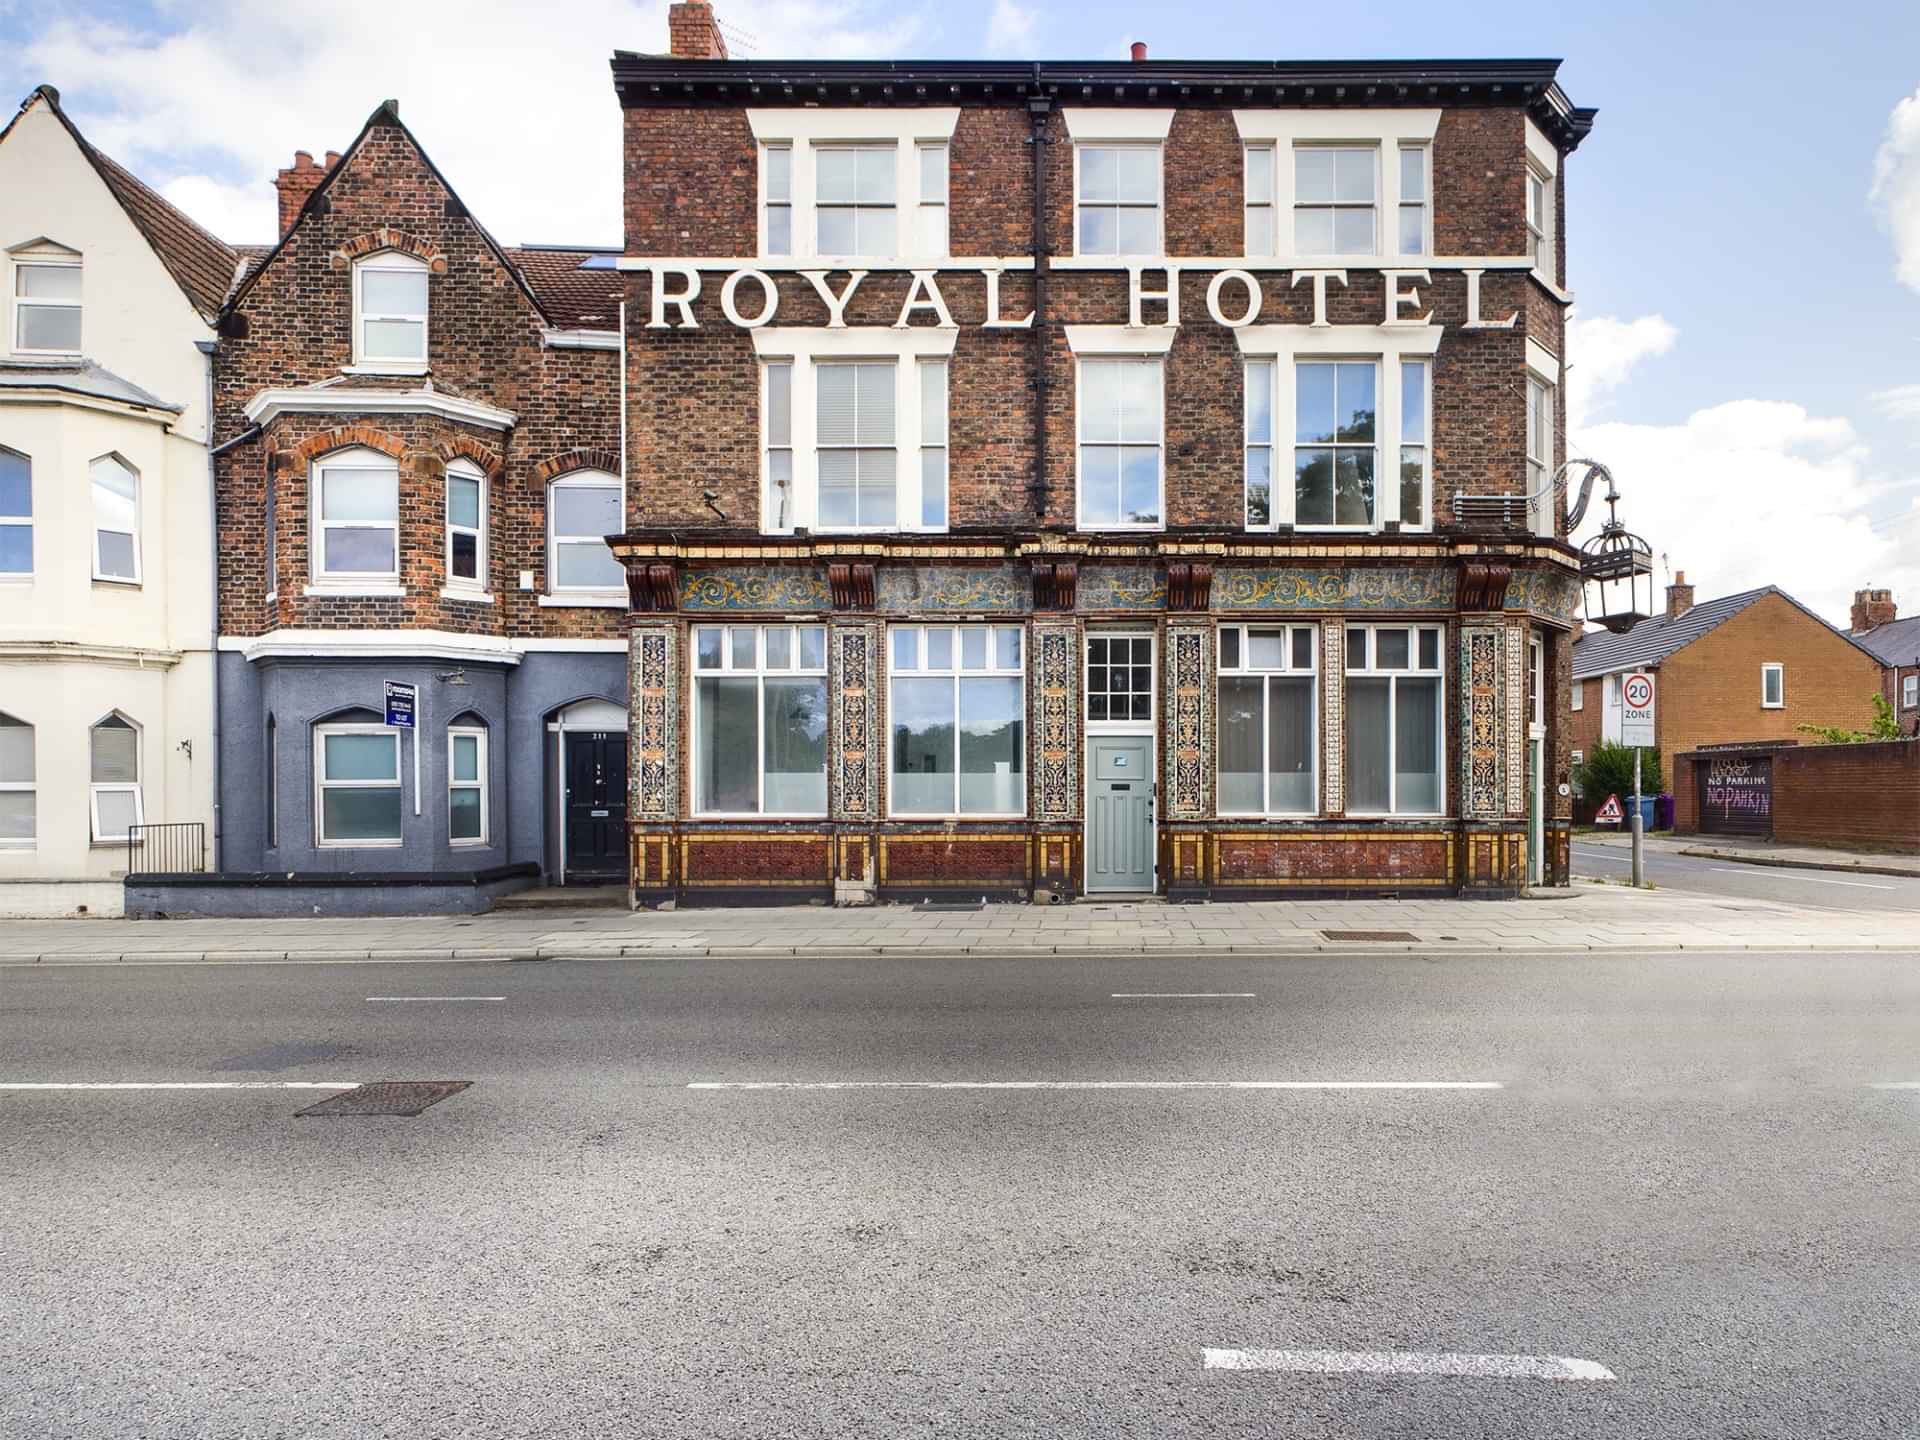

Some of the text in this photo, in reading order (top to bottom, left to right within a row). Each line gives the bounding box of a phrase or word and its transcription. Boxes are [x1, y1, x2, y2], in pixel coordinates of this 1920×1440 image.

[645, 266, 1519, 329] ROYAL HOTEL
[1629, 685, 1649, 698] 20
[1625, 710, 1651, 719] ZONE
[1708, 777, 1722, 785] NO
